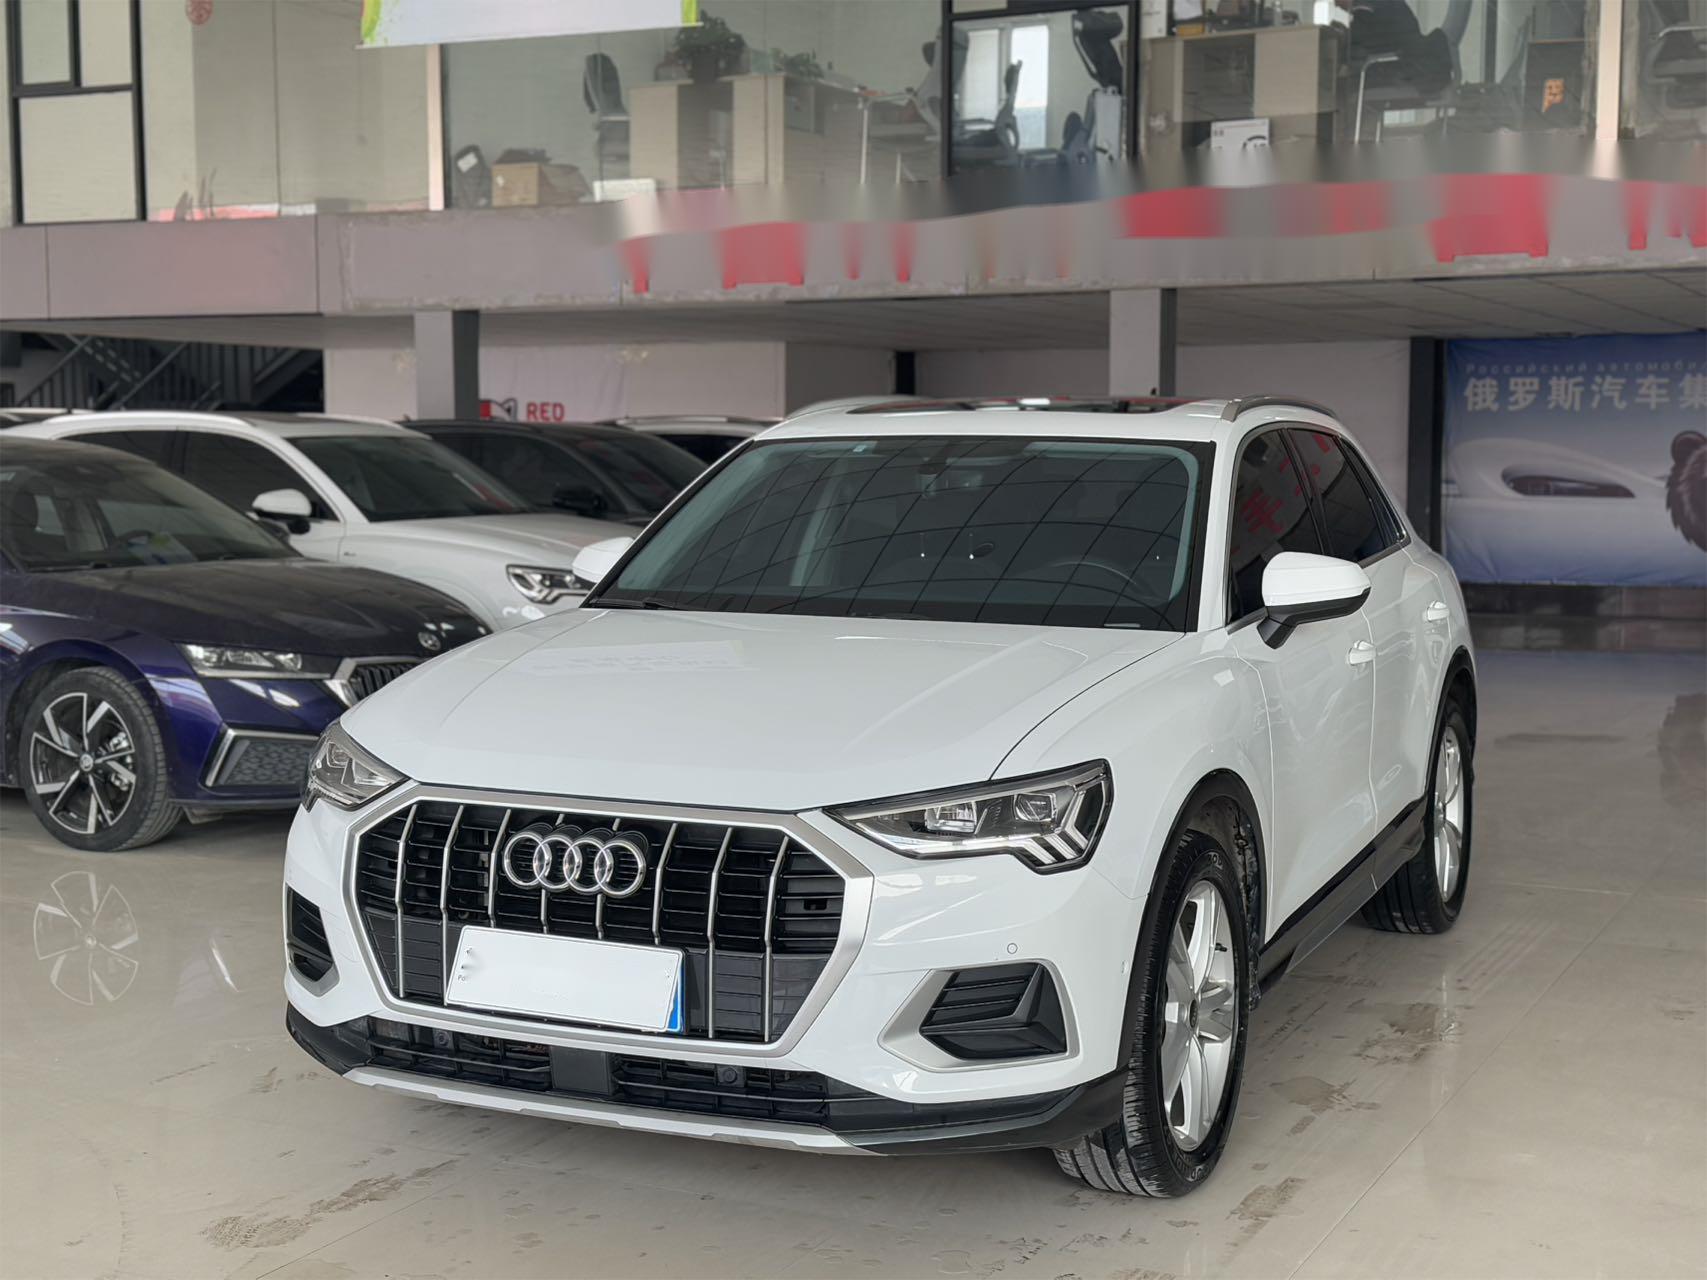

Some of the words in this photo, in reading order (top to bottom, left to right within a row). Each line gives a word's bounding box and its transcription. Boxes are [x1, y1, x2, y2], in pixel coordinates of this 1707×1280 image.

[1464, 374, 1707, 411] 俄罗斯汽车集
[526, 402, 565, 421] RED
